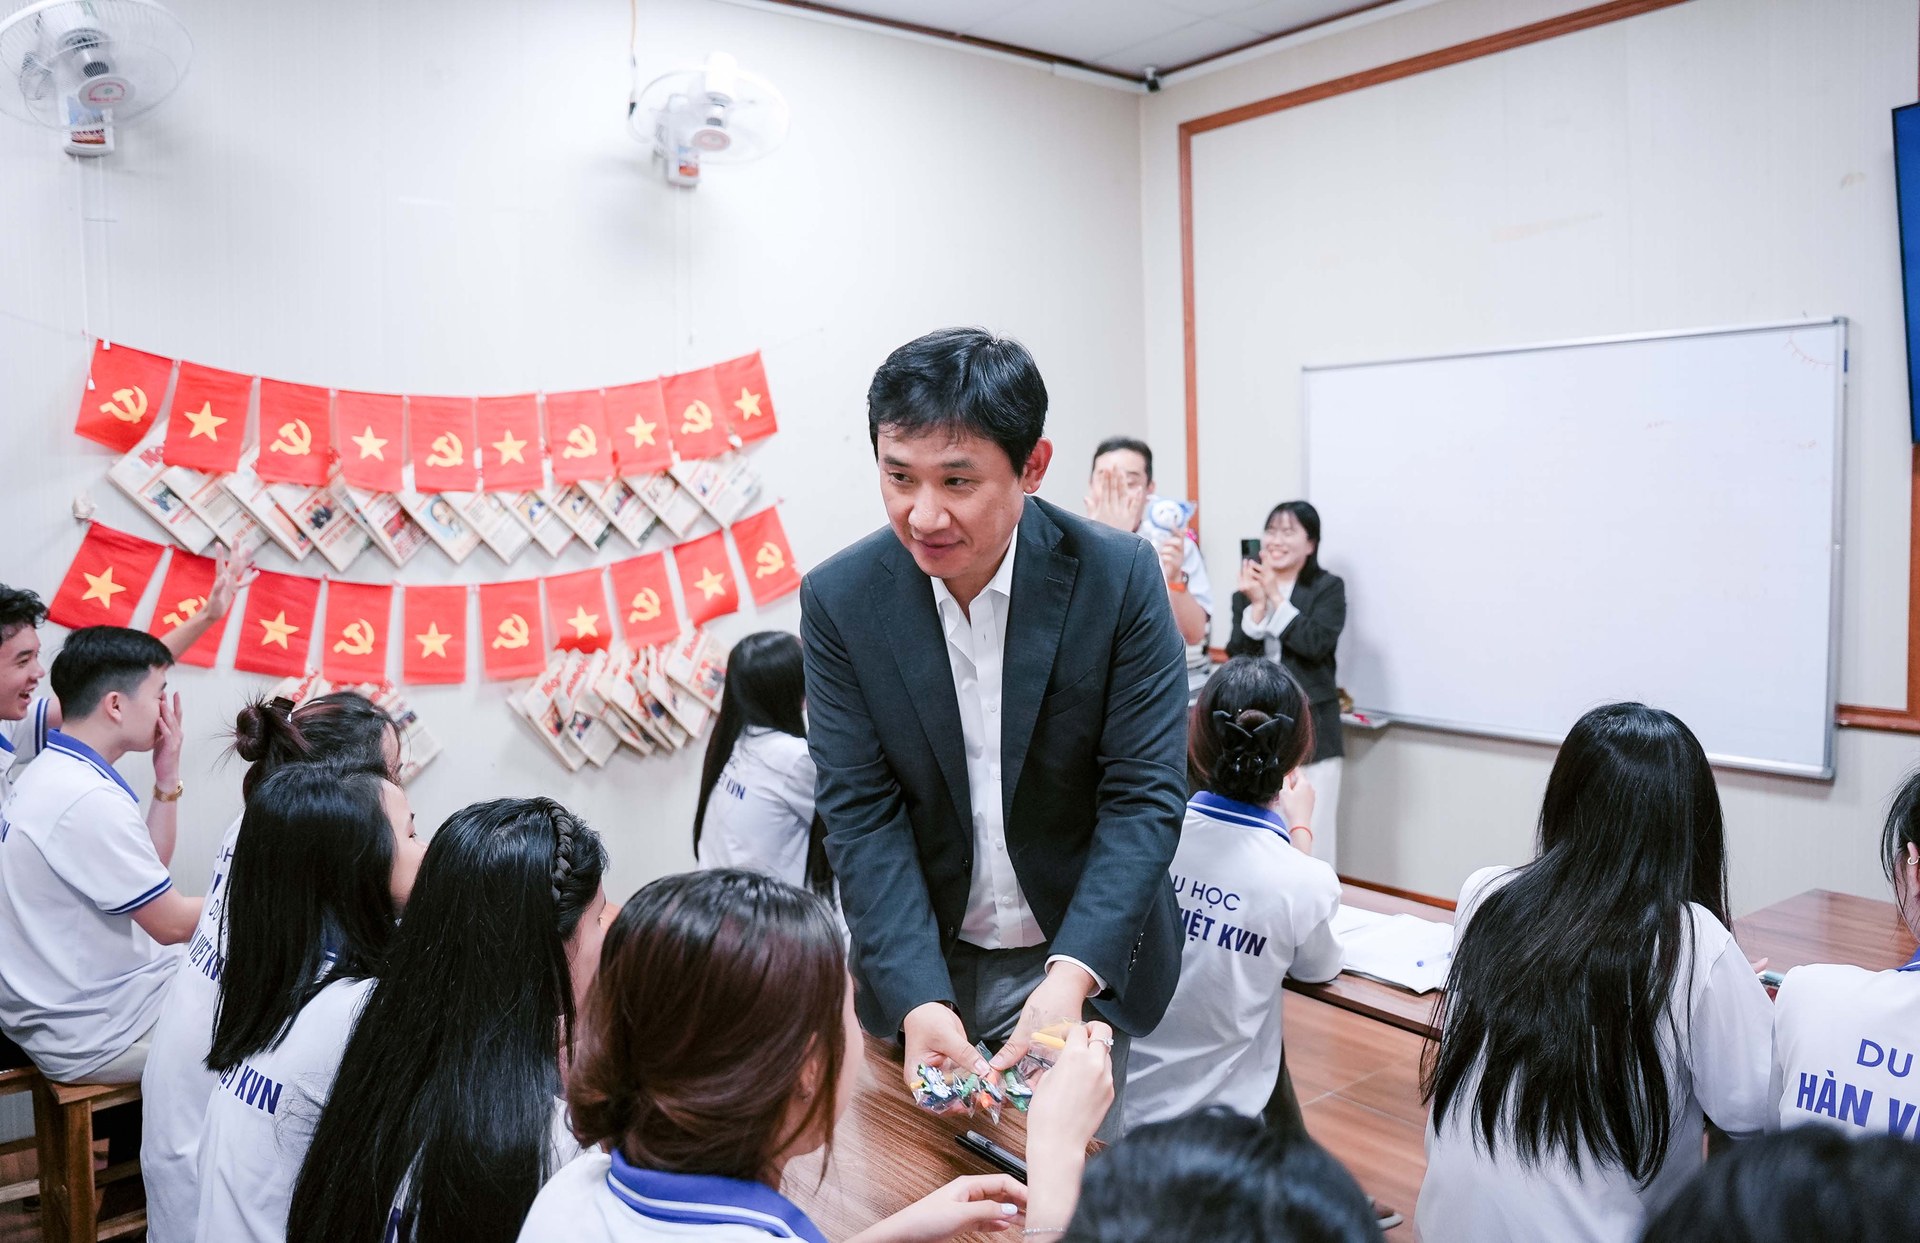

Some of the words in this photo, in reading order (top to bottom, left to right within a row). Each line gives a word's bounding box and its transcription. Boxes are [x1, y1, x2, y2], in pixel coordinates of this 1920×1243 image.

[1190, 881, 1241, 911] HỌC
[1179, 908, 1216, 942] IỆT
[1217, 923, 1268, 957] KVN
[1856, 1038, 1914, 1078] DU
[234, 1065, 283, 1115] KVN
[1796, 1069, 1874, 1128] HÀN
